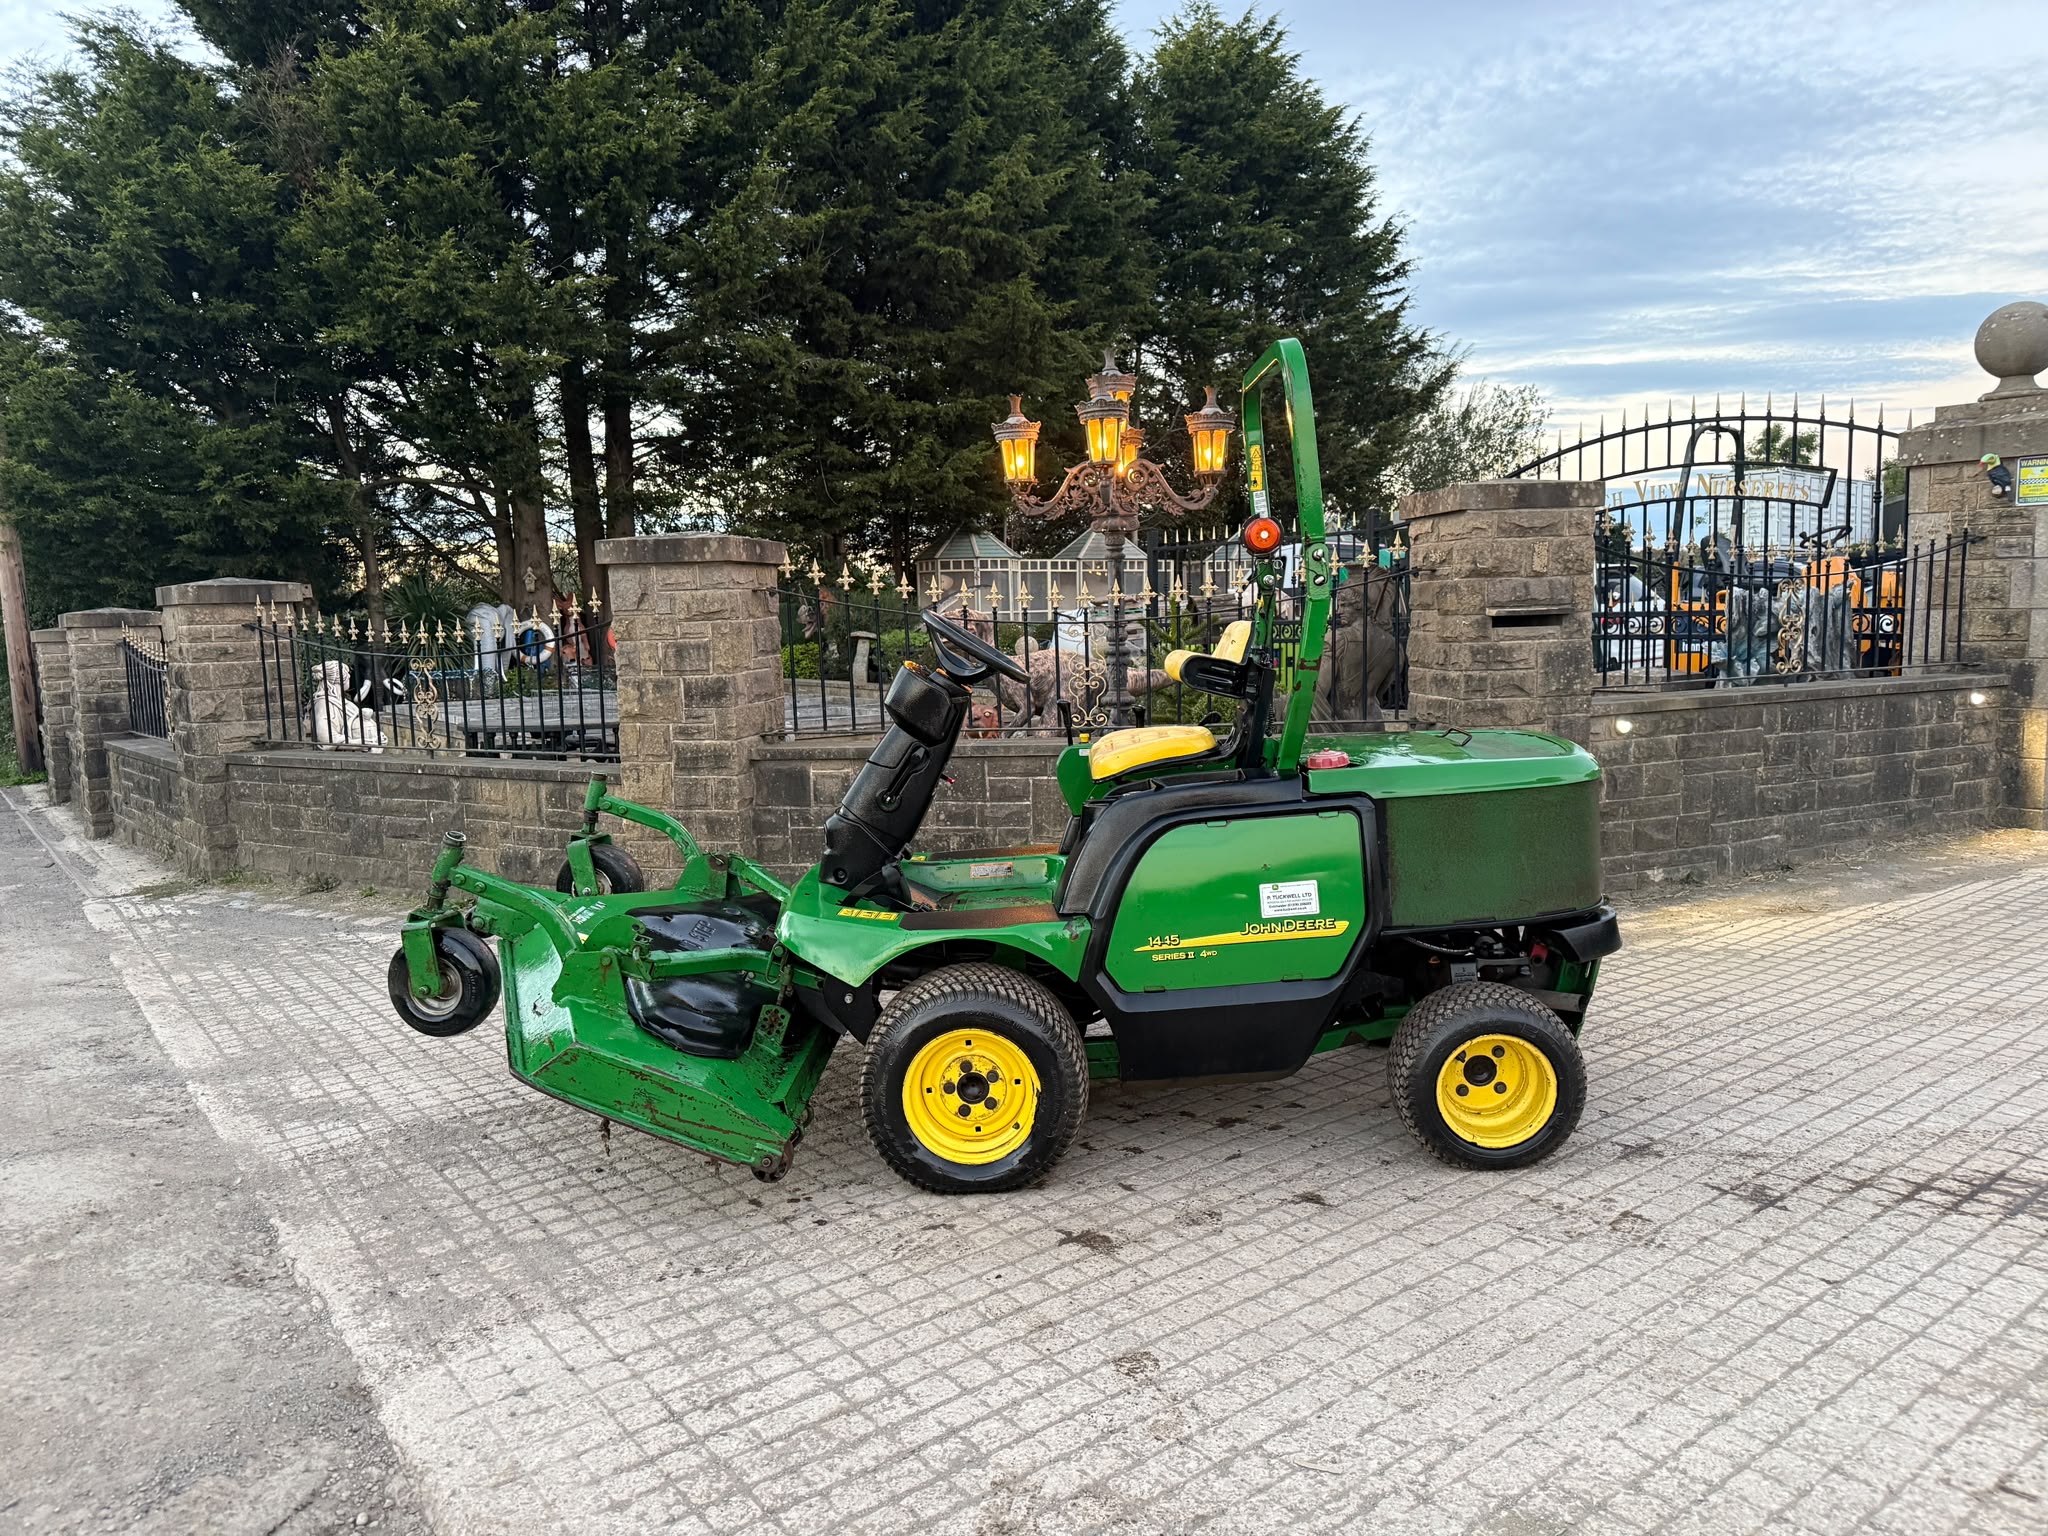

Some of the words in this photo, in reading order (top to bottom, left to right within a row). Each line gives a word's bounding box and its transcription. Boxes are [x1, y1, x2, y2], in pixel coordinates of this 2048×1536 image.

[1634, 479, 1684, 502] VIEW
[1696, 473, 1811, 501] NURSERIES
[1241, 922, 1284, 936] JOHN
[1284, 918, 1336, 932] DEERE
[1148, 934, 1180, 947] 1445
[1152, 952, 1186, 962] SERIES
